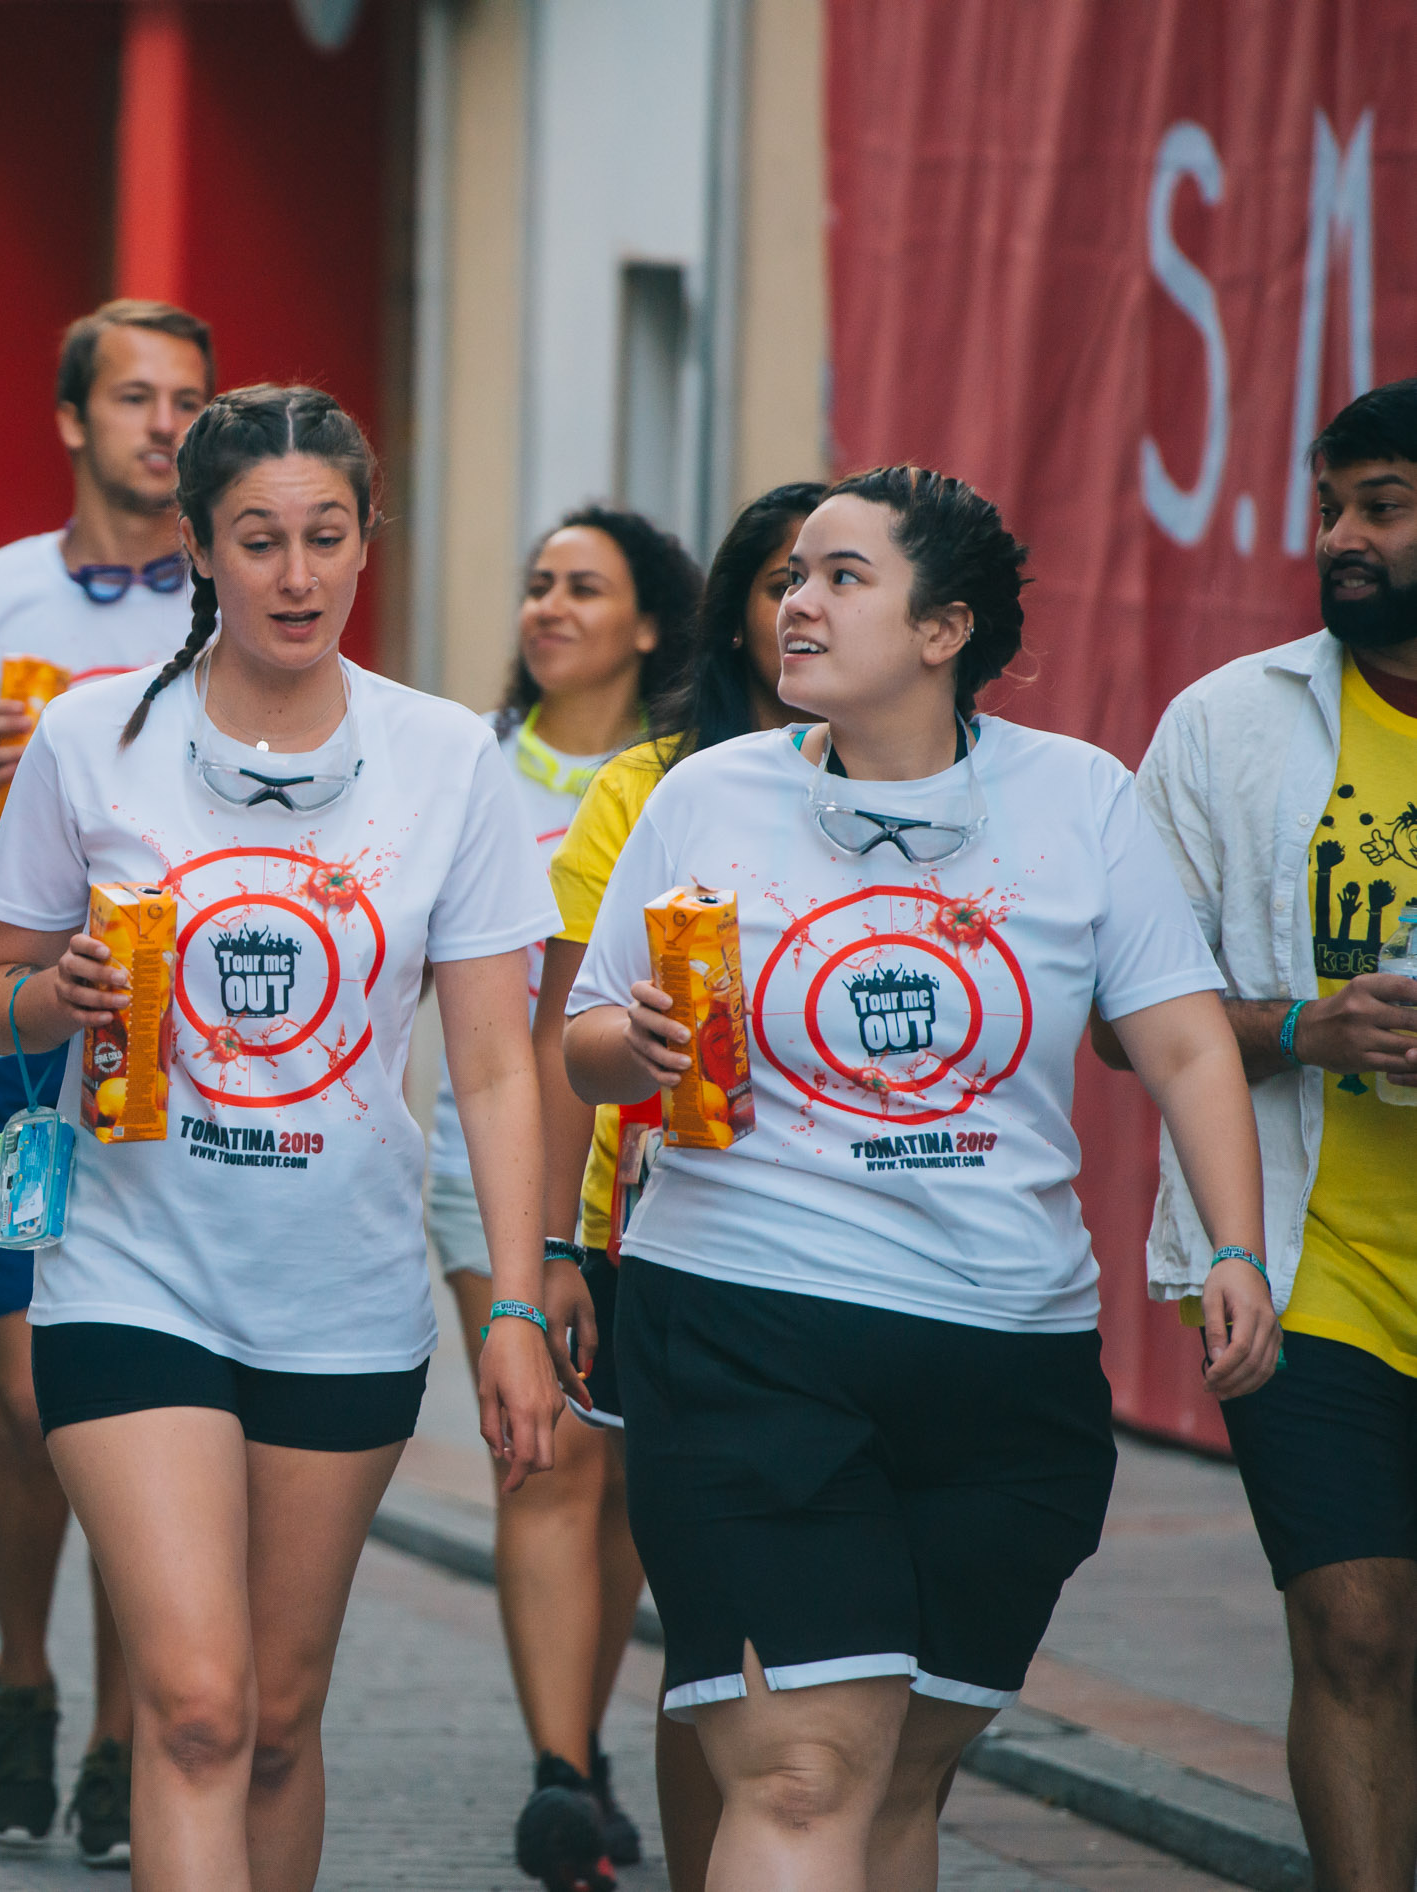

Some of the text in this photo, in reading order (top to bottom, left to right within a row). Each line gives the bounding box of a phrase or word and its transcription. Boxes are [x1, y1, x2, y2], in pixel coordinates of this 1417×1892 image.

[219, 951, 291, 973] Tour me
[225, 975, 290, 1012] OUT
[854, 989, 931, 1014] Tour me
[863, 1010, 932, 1050] OUT
[180, 1115, 324, 1154] TOMATINA 2019
[850, 1131, 998, 1159] TOMATINA 2019
[190, 1143, 308, 1169] WWW.TOURMEOUT.COM
[866, 1155, 985, 1171] WWW.TOURMEOUT.COM
